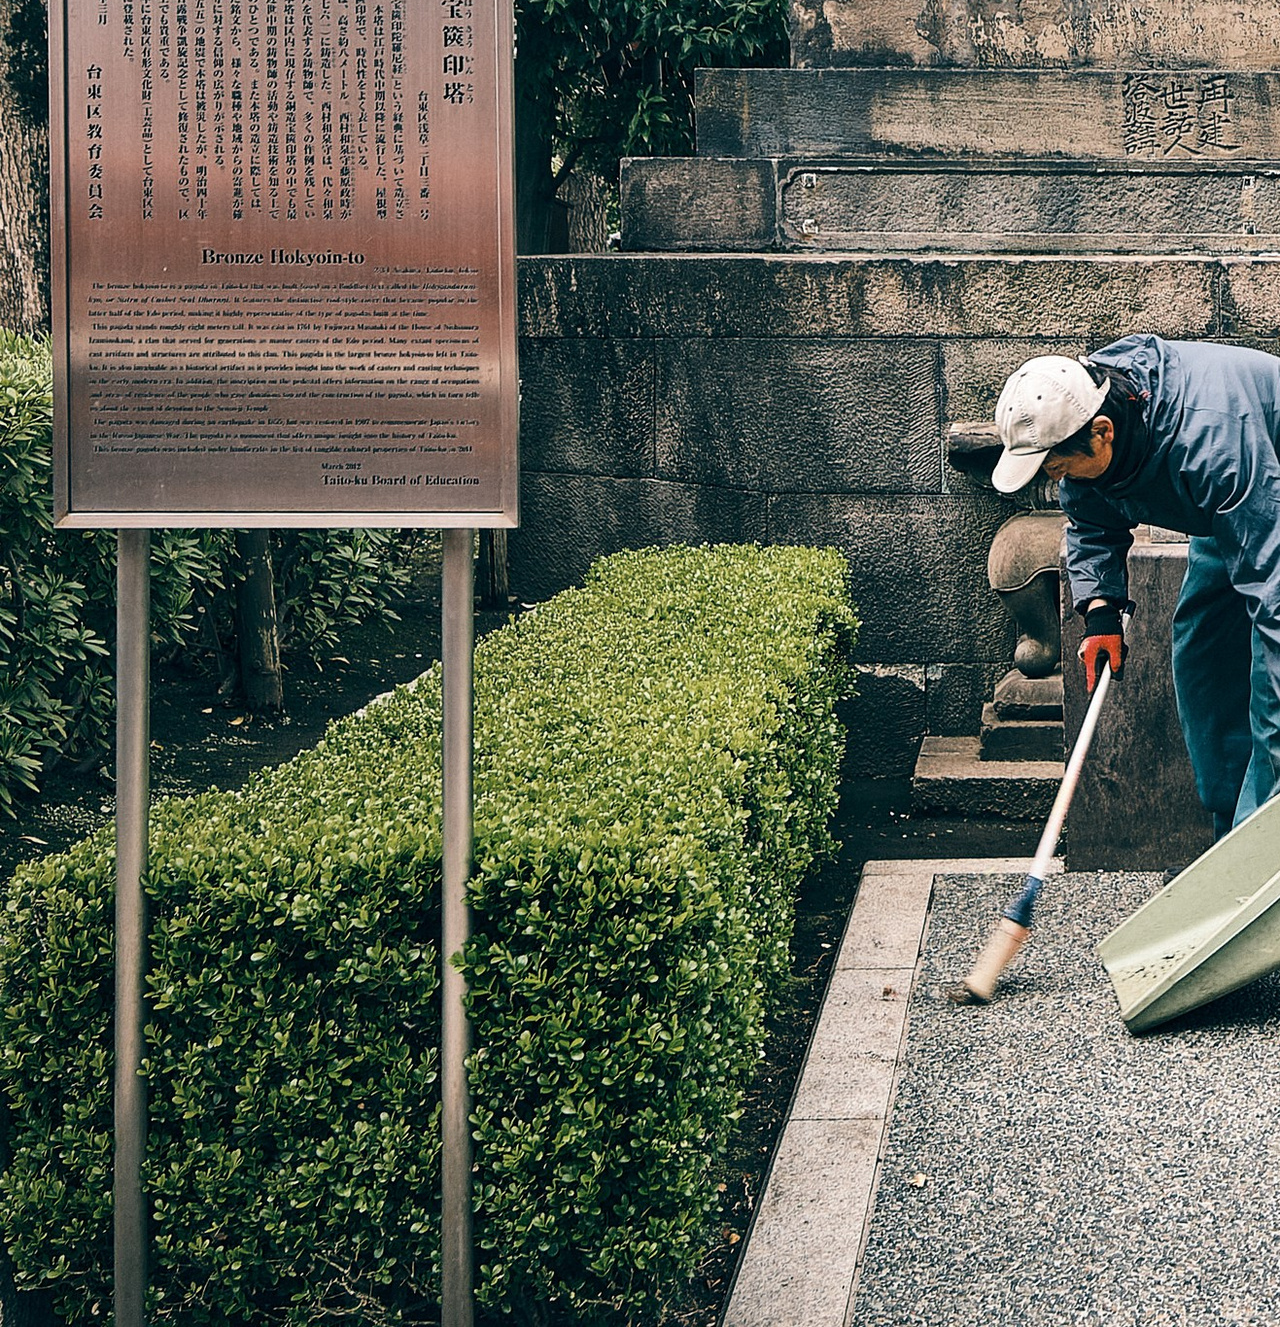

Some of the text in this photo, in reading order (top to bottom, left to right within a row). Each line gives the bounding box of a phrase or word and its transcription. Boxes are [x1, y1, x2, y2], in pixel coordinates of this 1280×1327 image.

[85, 63, 104, 219] 台東区教育委員会
[202, 248, 365, 267] Bronze Hokyoin-to
[320, 474, 480, 486] Taito-ku Board of Education
